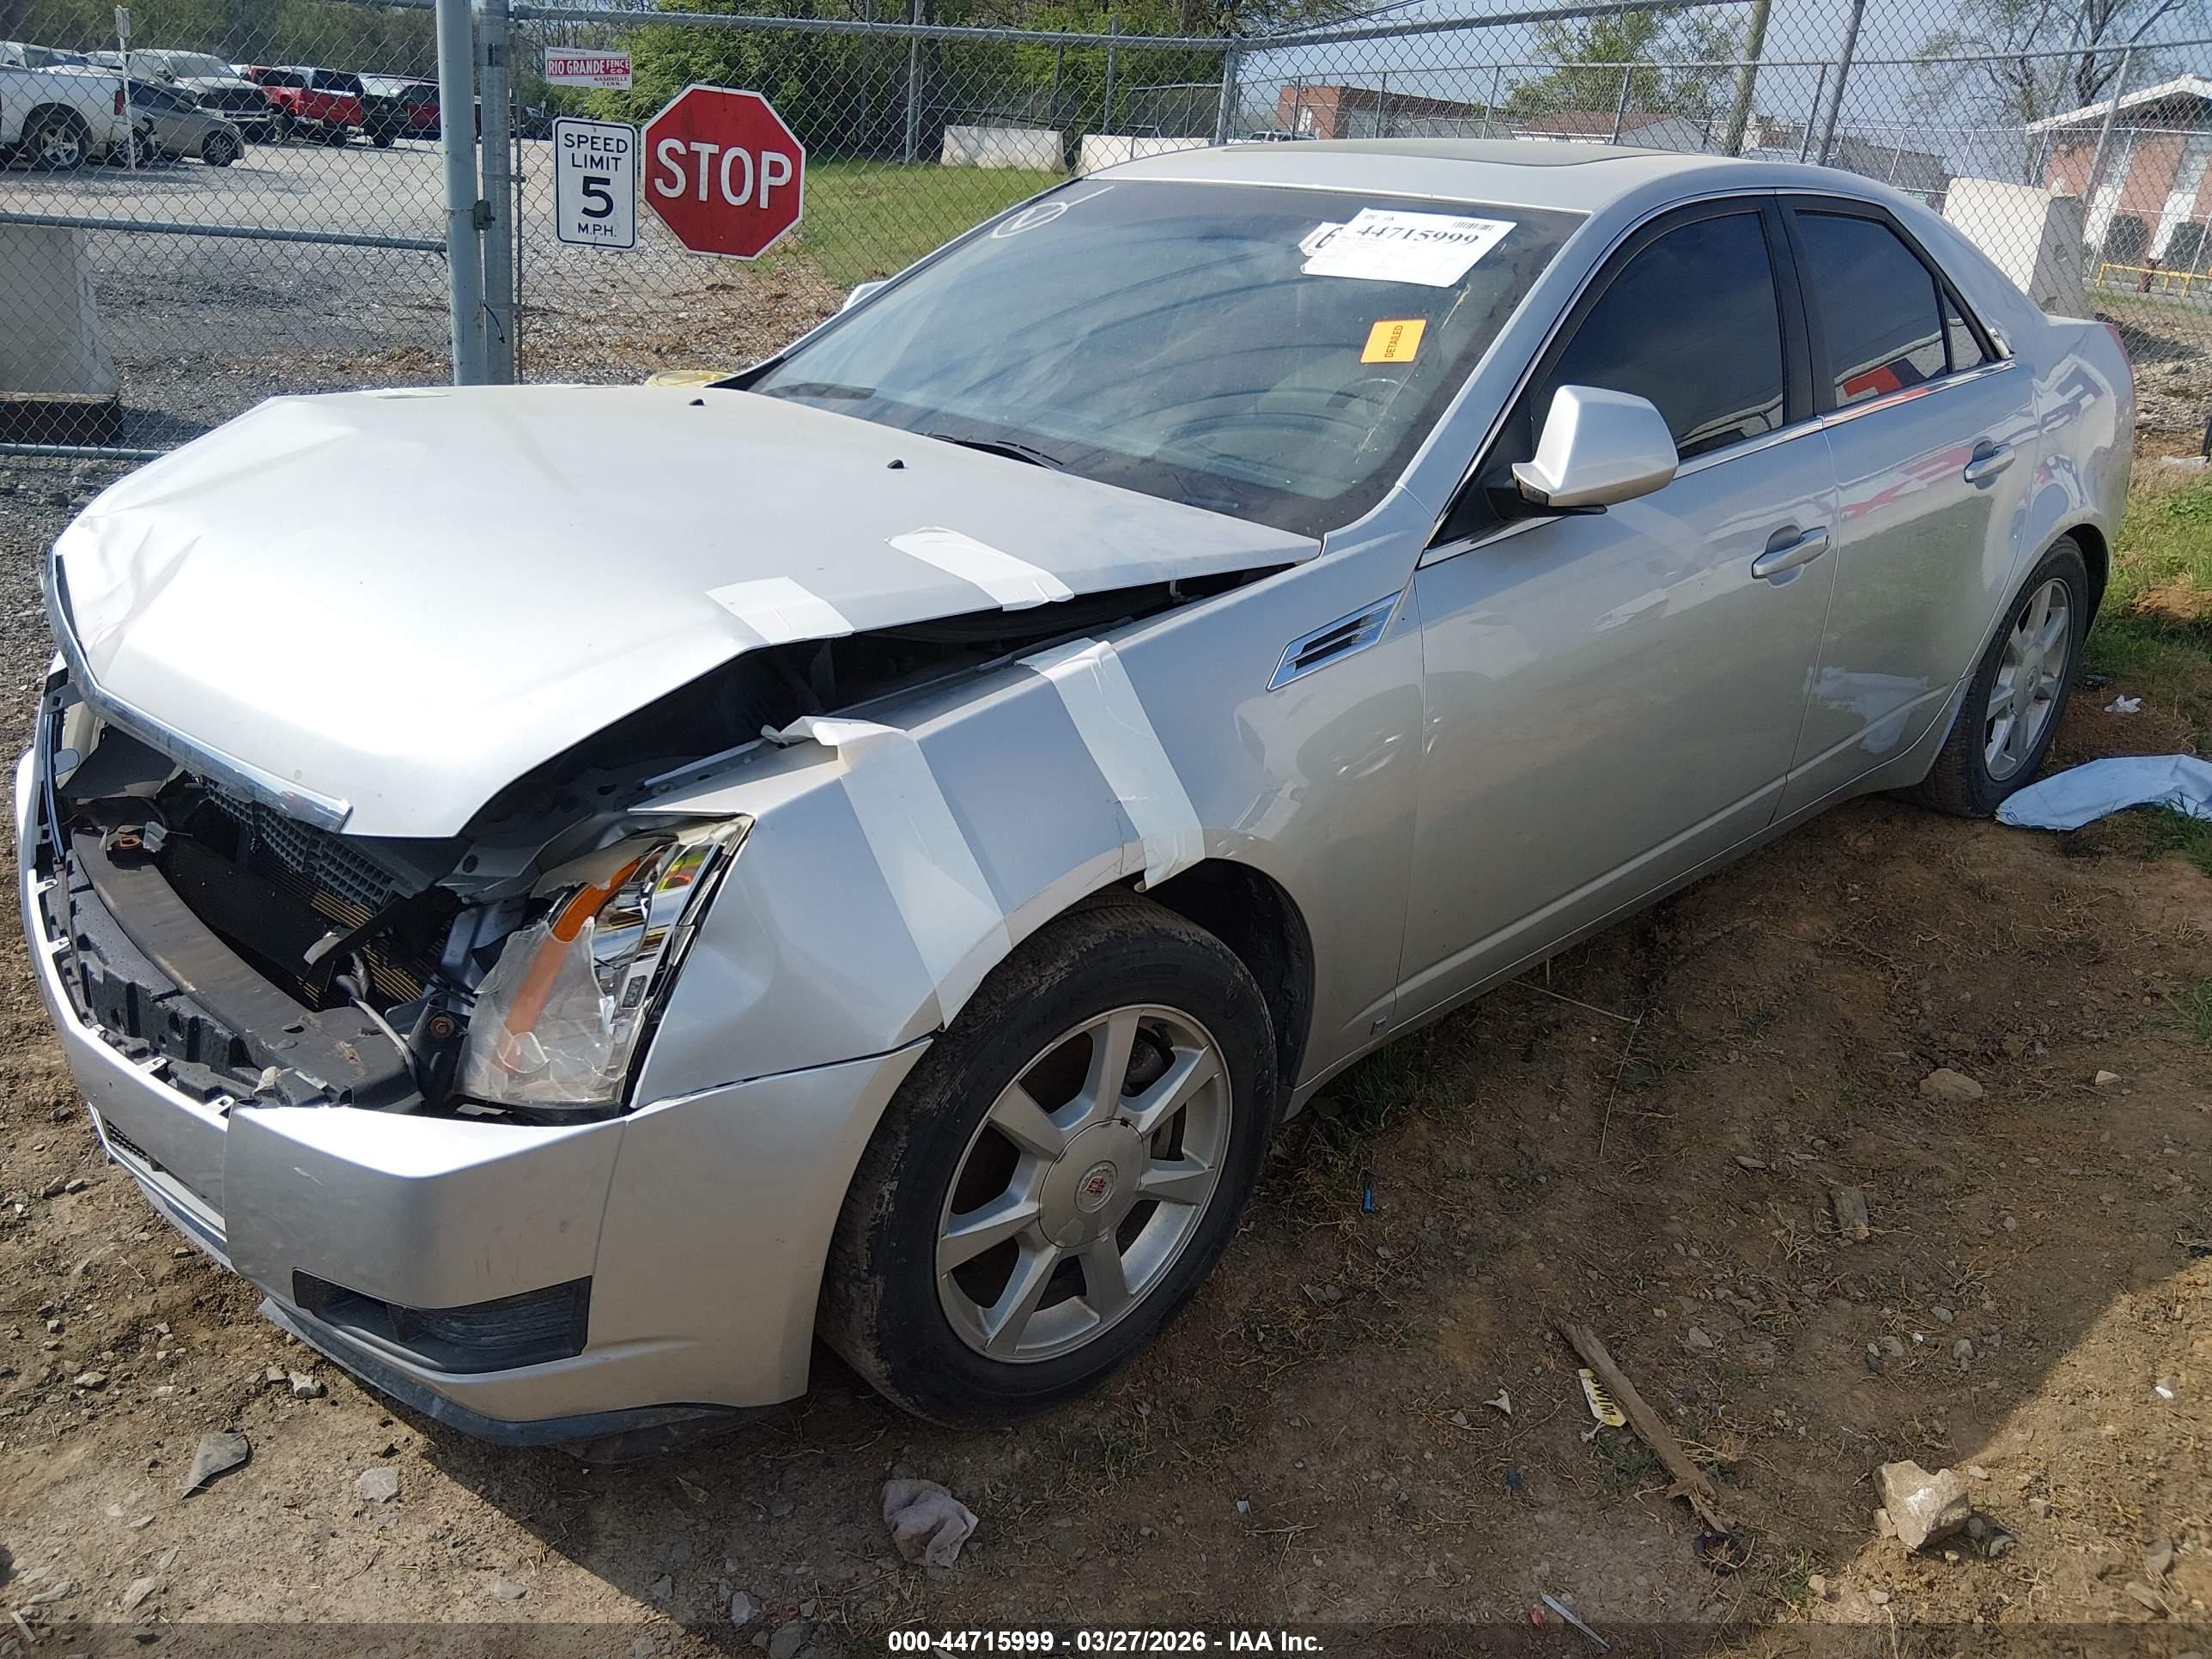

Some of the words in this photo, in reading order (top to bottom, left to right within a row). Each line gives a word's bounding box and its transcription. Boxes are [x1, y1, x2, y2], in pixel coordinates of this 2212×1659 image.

[548, 60, 565, 75] RIO
[567, 60, 605, 75] GRANDE
[606, 59, 629, 70] FENCE
[563, 133, 629, 153] SPEED
[571, 152, 622, 172] LIMIT
[654, 137, 793, 210] STOP
[581, 175, 614, 218] 5
[577, 222, 617, 238] M.P.H.
[1356, 224, 1480, 246] 44715999
[1384, 325, 1404, 358] DETAILED
